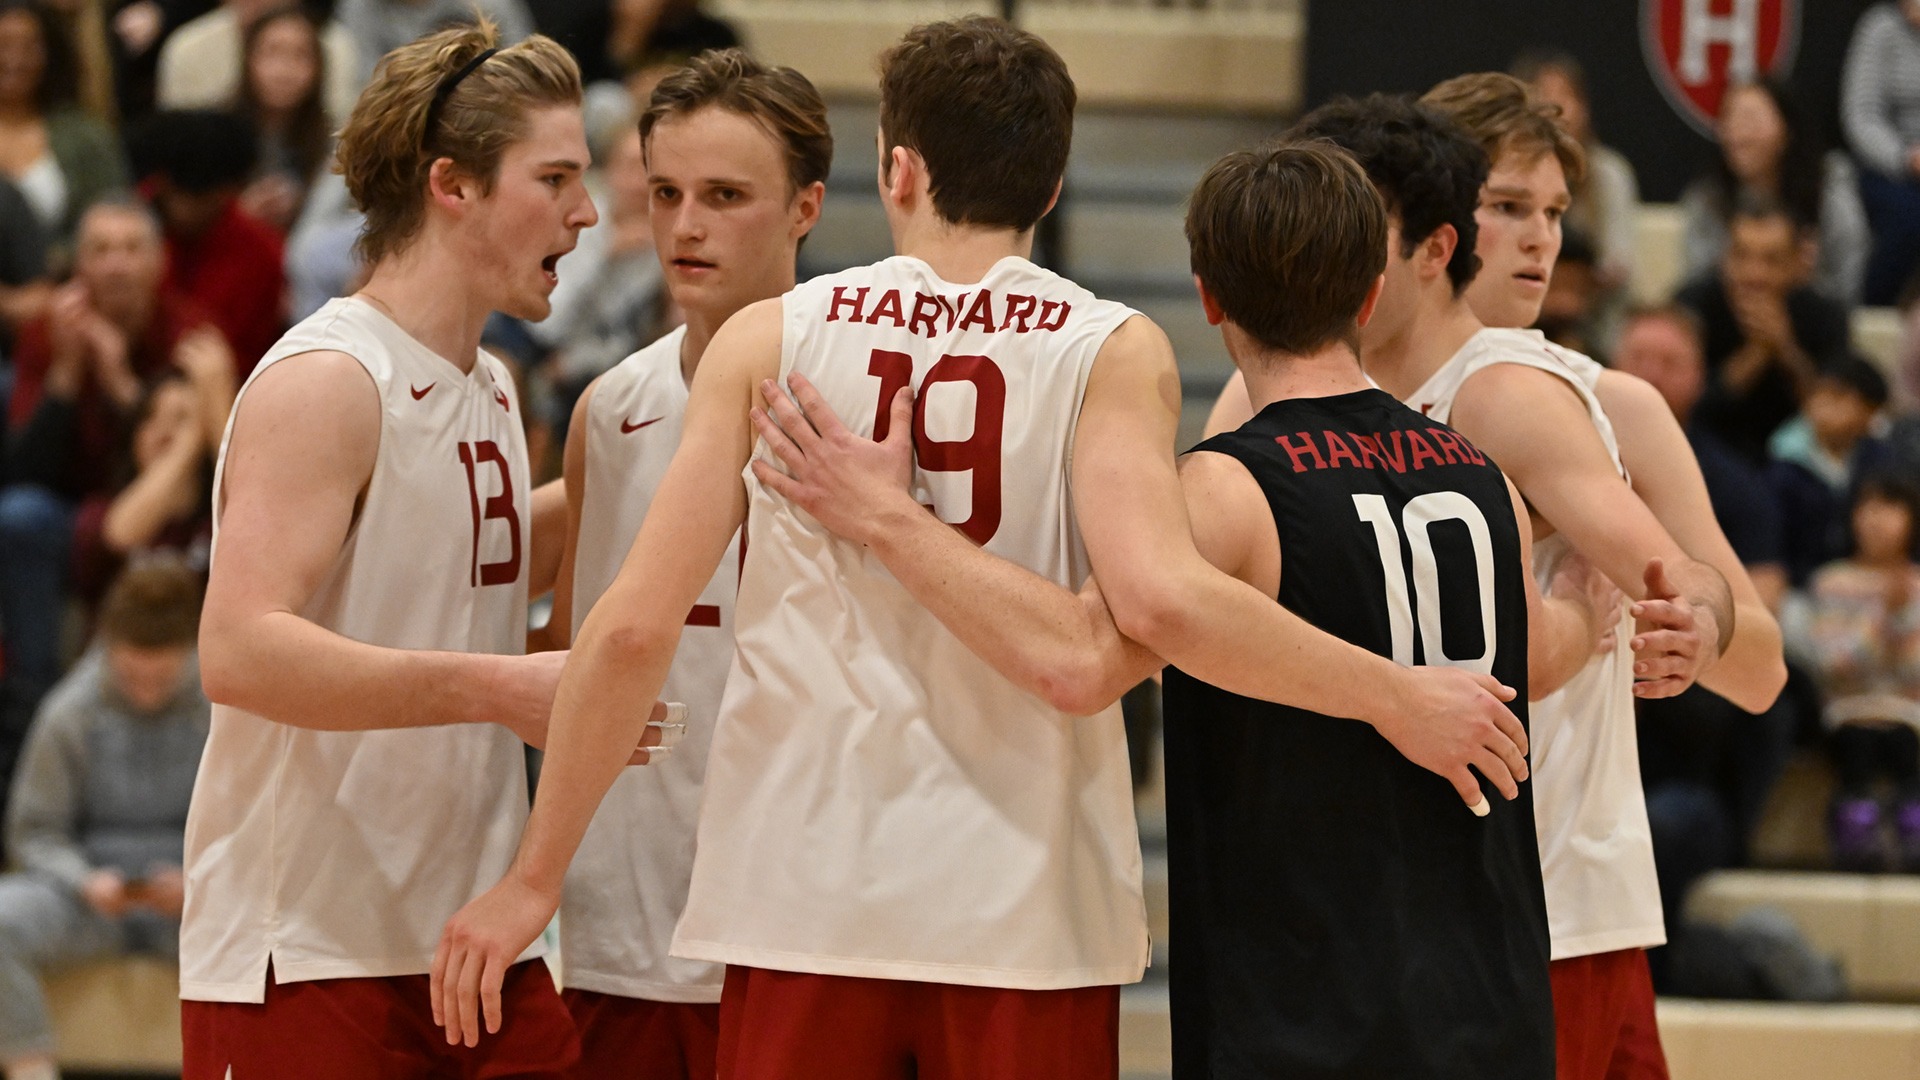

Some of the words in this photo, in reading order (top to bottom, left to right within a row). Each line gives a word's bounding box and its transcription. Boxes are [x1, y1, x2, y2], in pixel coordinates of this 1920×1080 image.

[826, 286, 1072, 338] HARVARD
[458, 440, 522, 587] 13
[867, 348, 1006, 548] 19
[1275, 428, 1486, 474] HARVARD
[1351, 491, 1497, 676] 10
